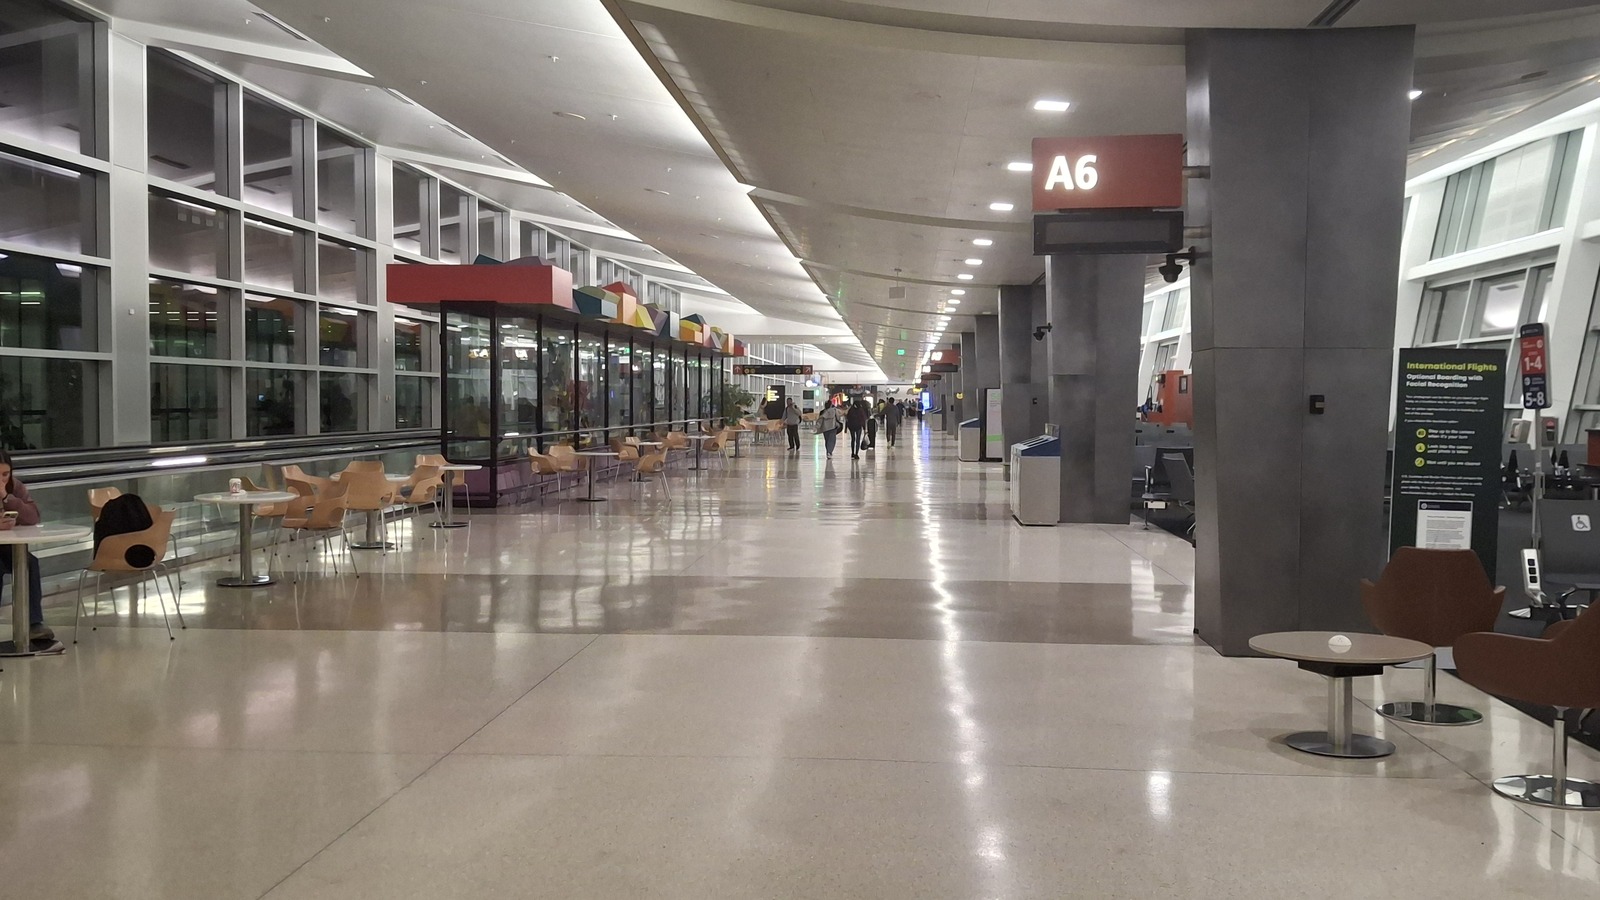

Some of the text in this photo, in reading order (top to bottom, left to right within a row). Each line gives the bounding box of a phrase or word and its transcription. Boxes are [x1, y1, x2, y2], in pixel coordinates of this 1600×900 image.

[1045, 154, 1098, 190] A6
[1406, 362, 1497, 372] International Flights
[1524, 356, 1542, 371] 1-4
[1525, 392, 1545, 406] 5-8
